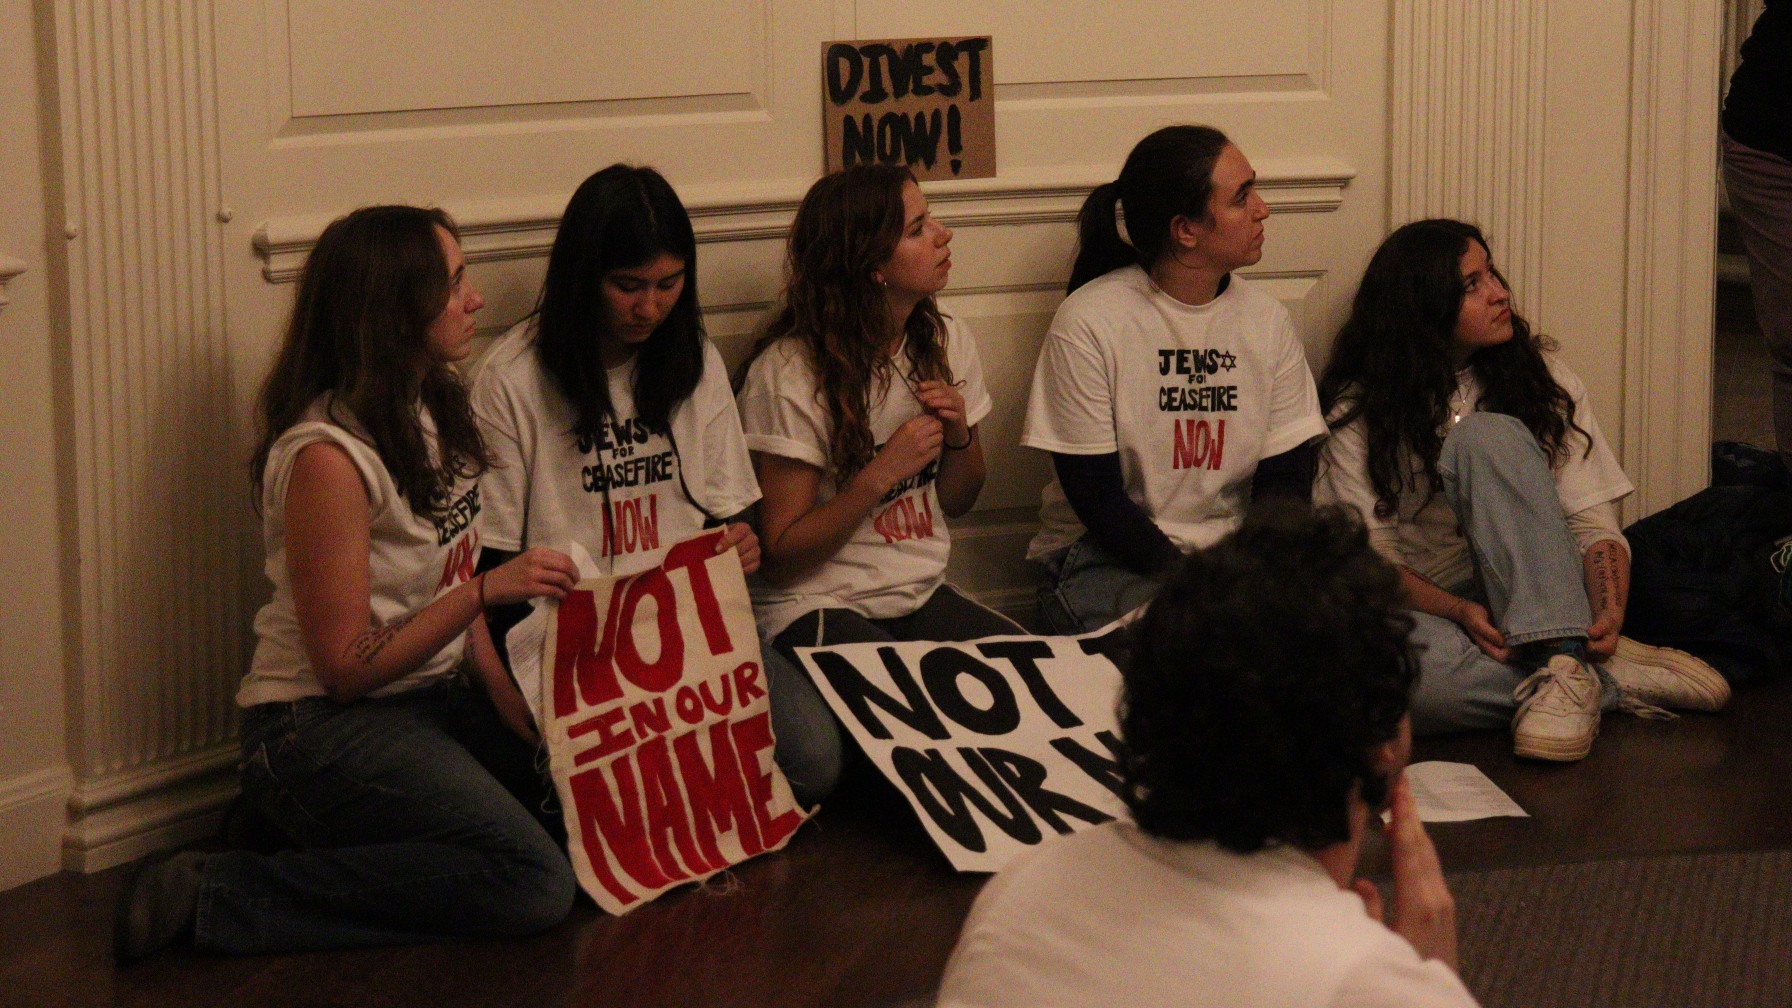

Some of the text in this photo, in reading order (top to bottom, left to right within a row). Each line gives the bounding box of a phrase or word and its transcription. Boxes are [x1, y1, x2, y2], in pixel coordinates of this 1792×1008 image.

[827, 38, 989, 105] DIVEST
[842, 104, 963, 176] NOW!
[1158, 349, 1220, 376] JEWS
[1159, 386, 1238, 412] CEASEFIRE
[581, 451, 673, 493] CEASEFIRE
[612, 446, 635, 460] FOR
[1173, 419, 1225, 470] NOW
[601, 494, 659, 558] NOW
[553, 531, 734, 719] NOT
[567, 661, 766, 768] IN OUR
[811, 640, 1085, 740] NOT
[569, 711, 804, 905] NAME
[891, 746, 1118, 853] OUR
